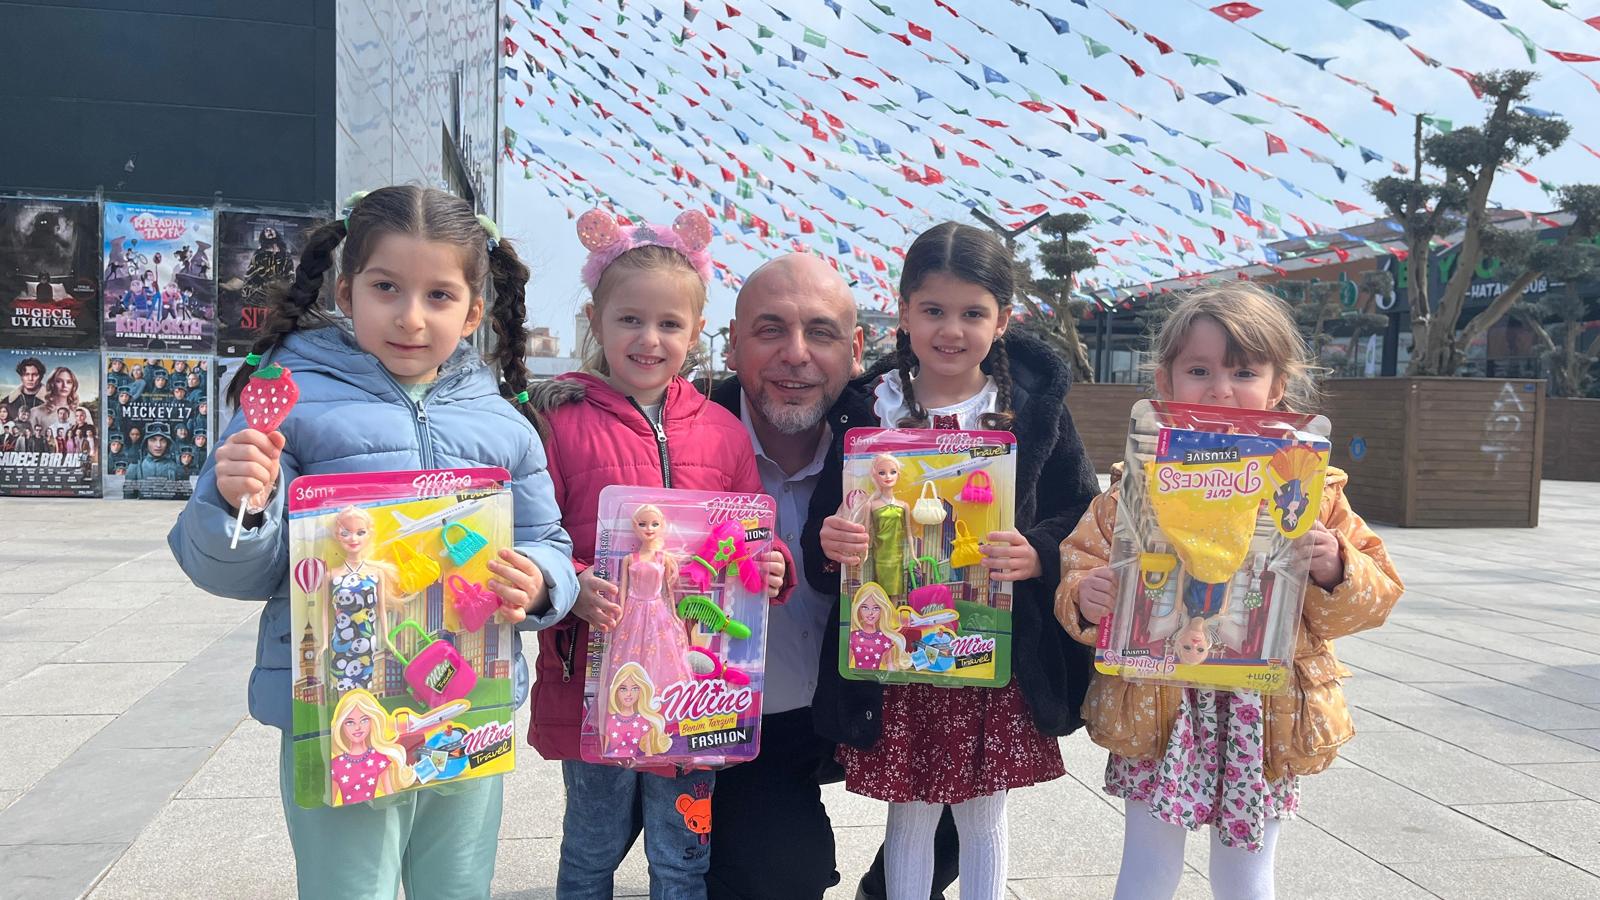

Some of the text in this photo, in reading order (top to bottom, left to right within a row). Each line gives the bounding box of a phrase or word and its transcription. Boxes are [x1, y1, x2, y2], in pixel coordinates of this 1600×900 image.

[15, 307, 72, 319] BU GECE
[11, 316, 76, 327] UYKU YOK
[122, 406, 192, 419] MICKEY 17
[1187, 451, 1237, 462] EXLUSIVE
[1159, 461, 1261, 494] PRINCESS
[296, 486, 336, 500] 36m+
[1206, 489, 1232, 499] CUTE
[950, 635, 996, 657] Mine
[959, 654, 991, 667] Travel
[662, 680, 751, 721] Mine
[682, 723, 706, 734] Benim
[462, 722, 513, 754] Mine
[691, 730, 746, 749] FASHION
[472, 740, 510, 764] Travel
